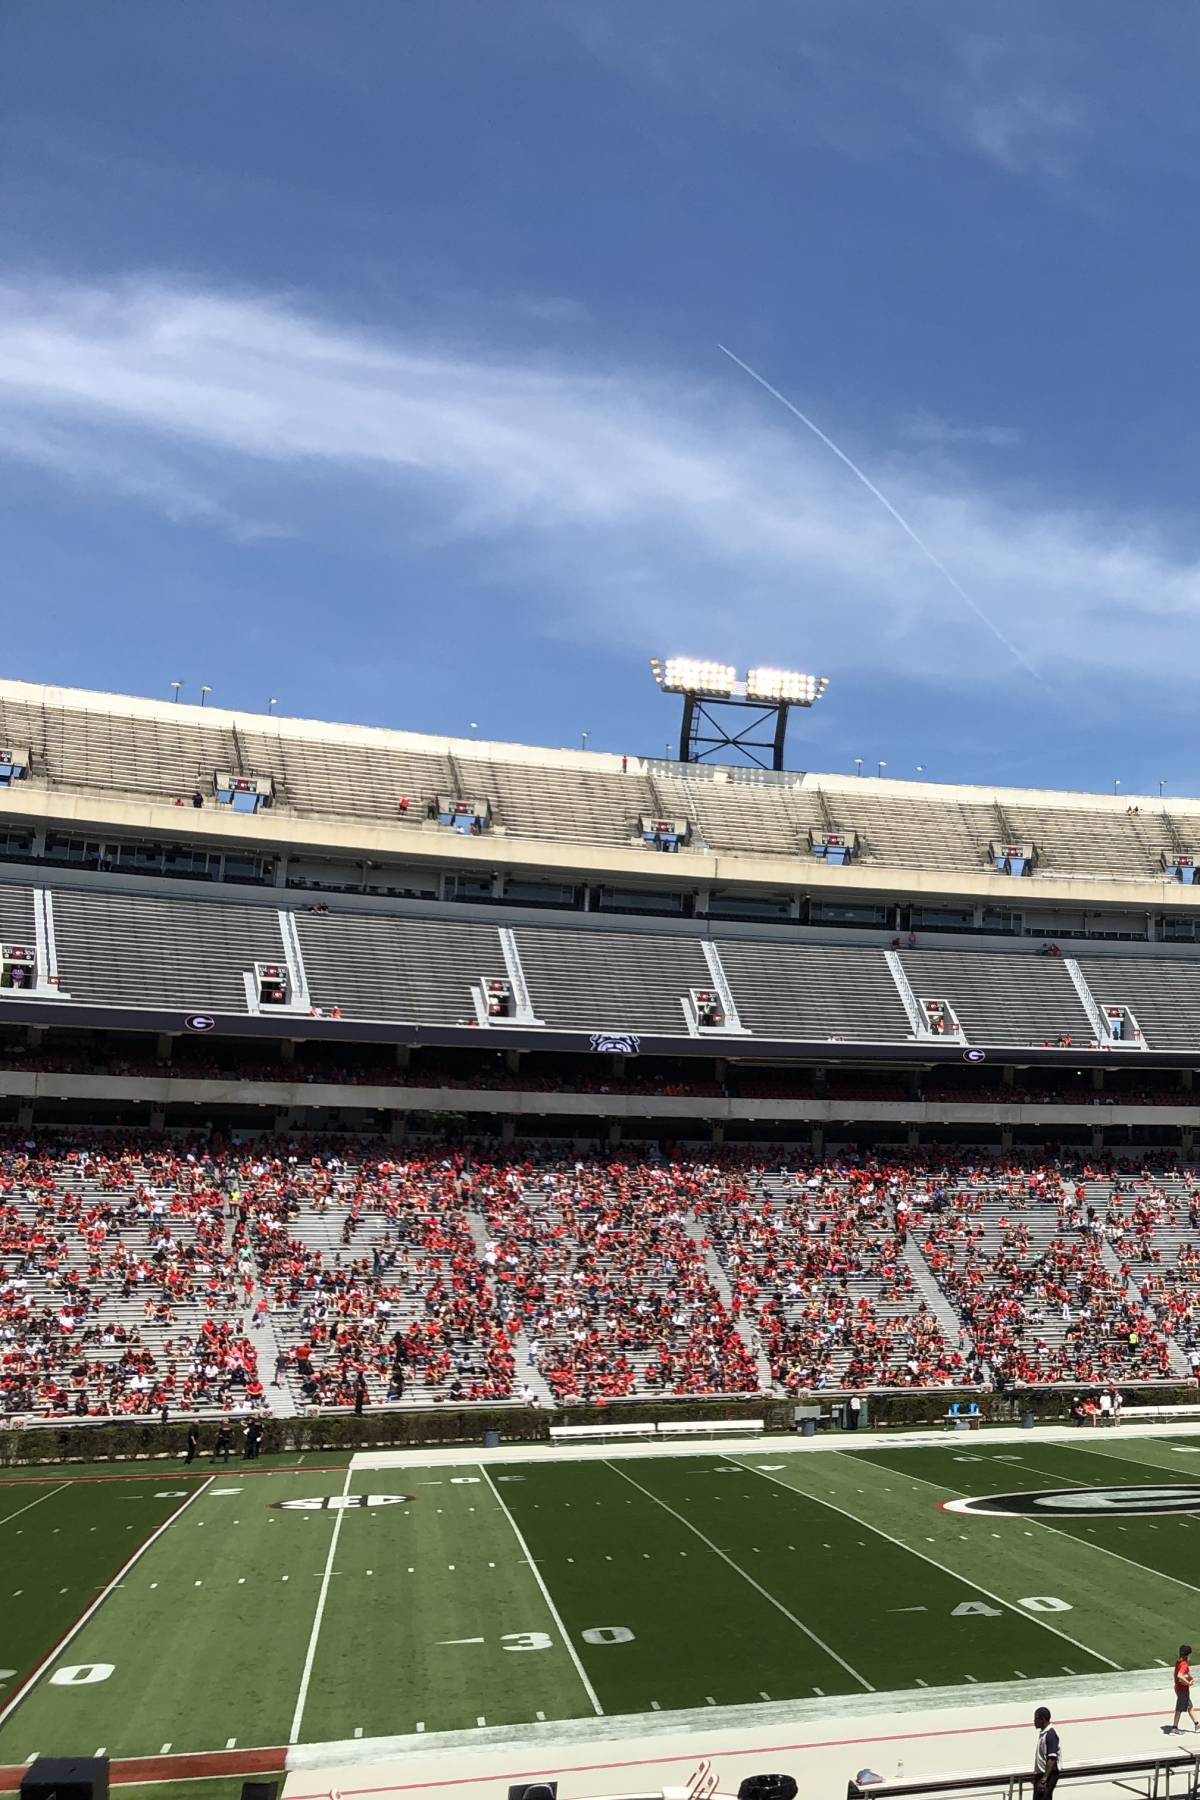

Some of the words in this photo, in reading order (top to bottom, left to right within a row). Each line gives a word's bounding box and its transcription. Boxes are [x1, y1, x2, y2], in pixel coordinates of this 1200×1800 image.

[280, 1495, 407, 1510] SEC
[950, 1596, 1075, 1617] 40
[500, 1626, 636, 1651] 30
